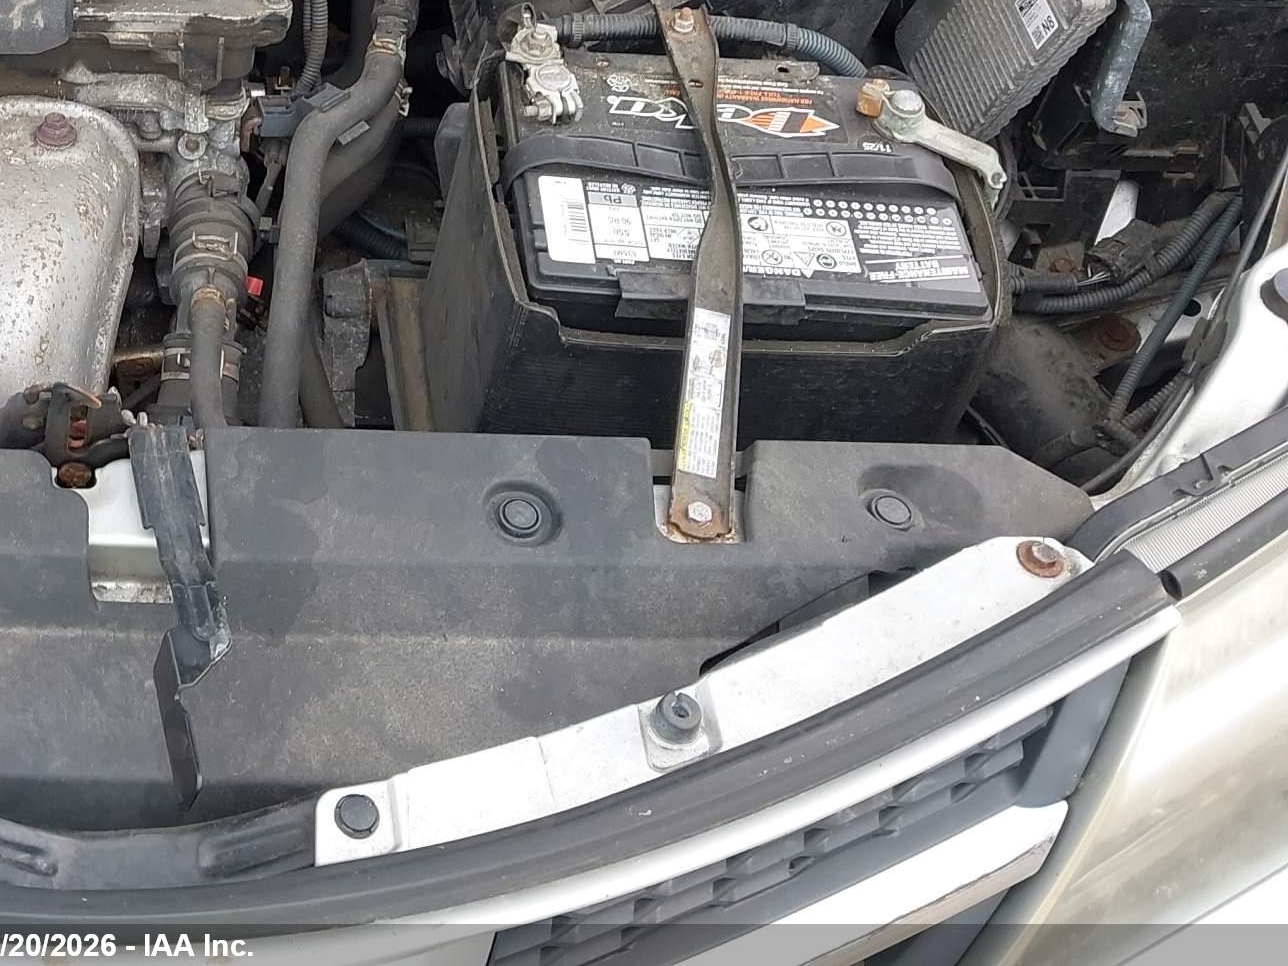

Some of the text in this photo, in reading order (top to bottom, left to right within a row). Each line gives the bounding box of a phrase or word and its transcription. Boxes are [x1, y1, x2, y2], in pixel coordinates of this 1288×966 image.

[862, 142, 892, 153] 11/25
[603, 194, 622, 205] Pb
[895, 260, 939, 273] BATTERY
[869, 265, 969, 282] MAINTENANCE-FREE
